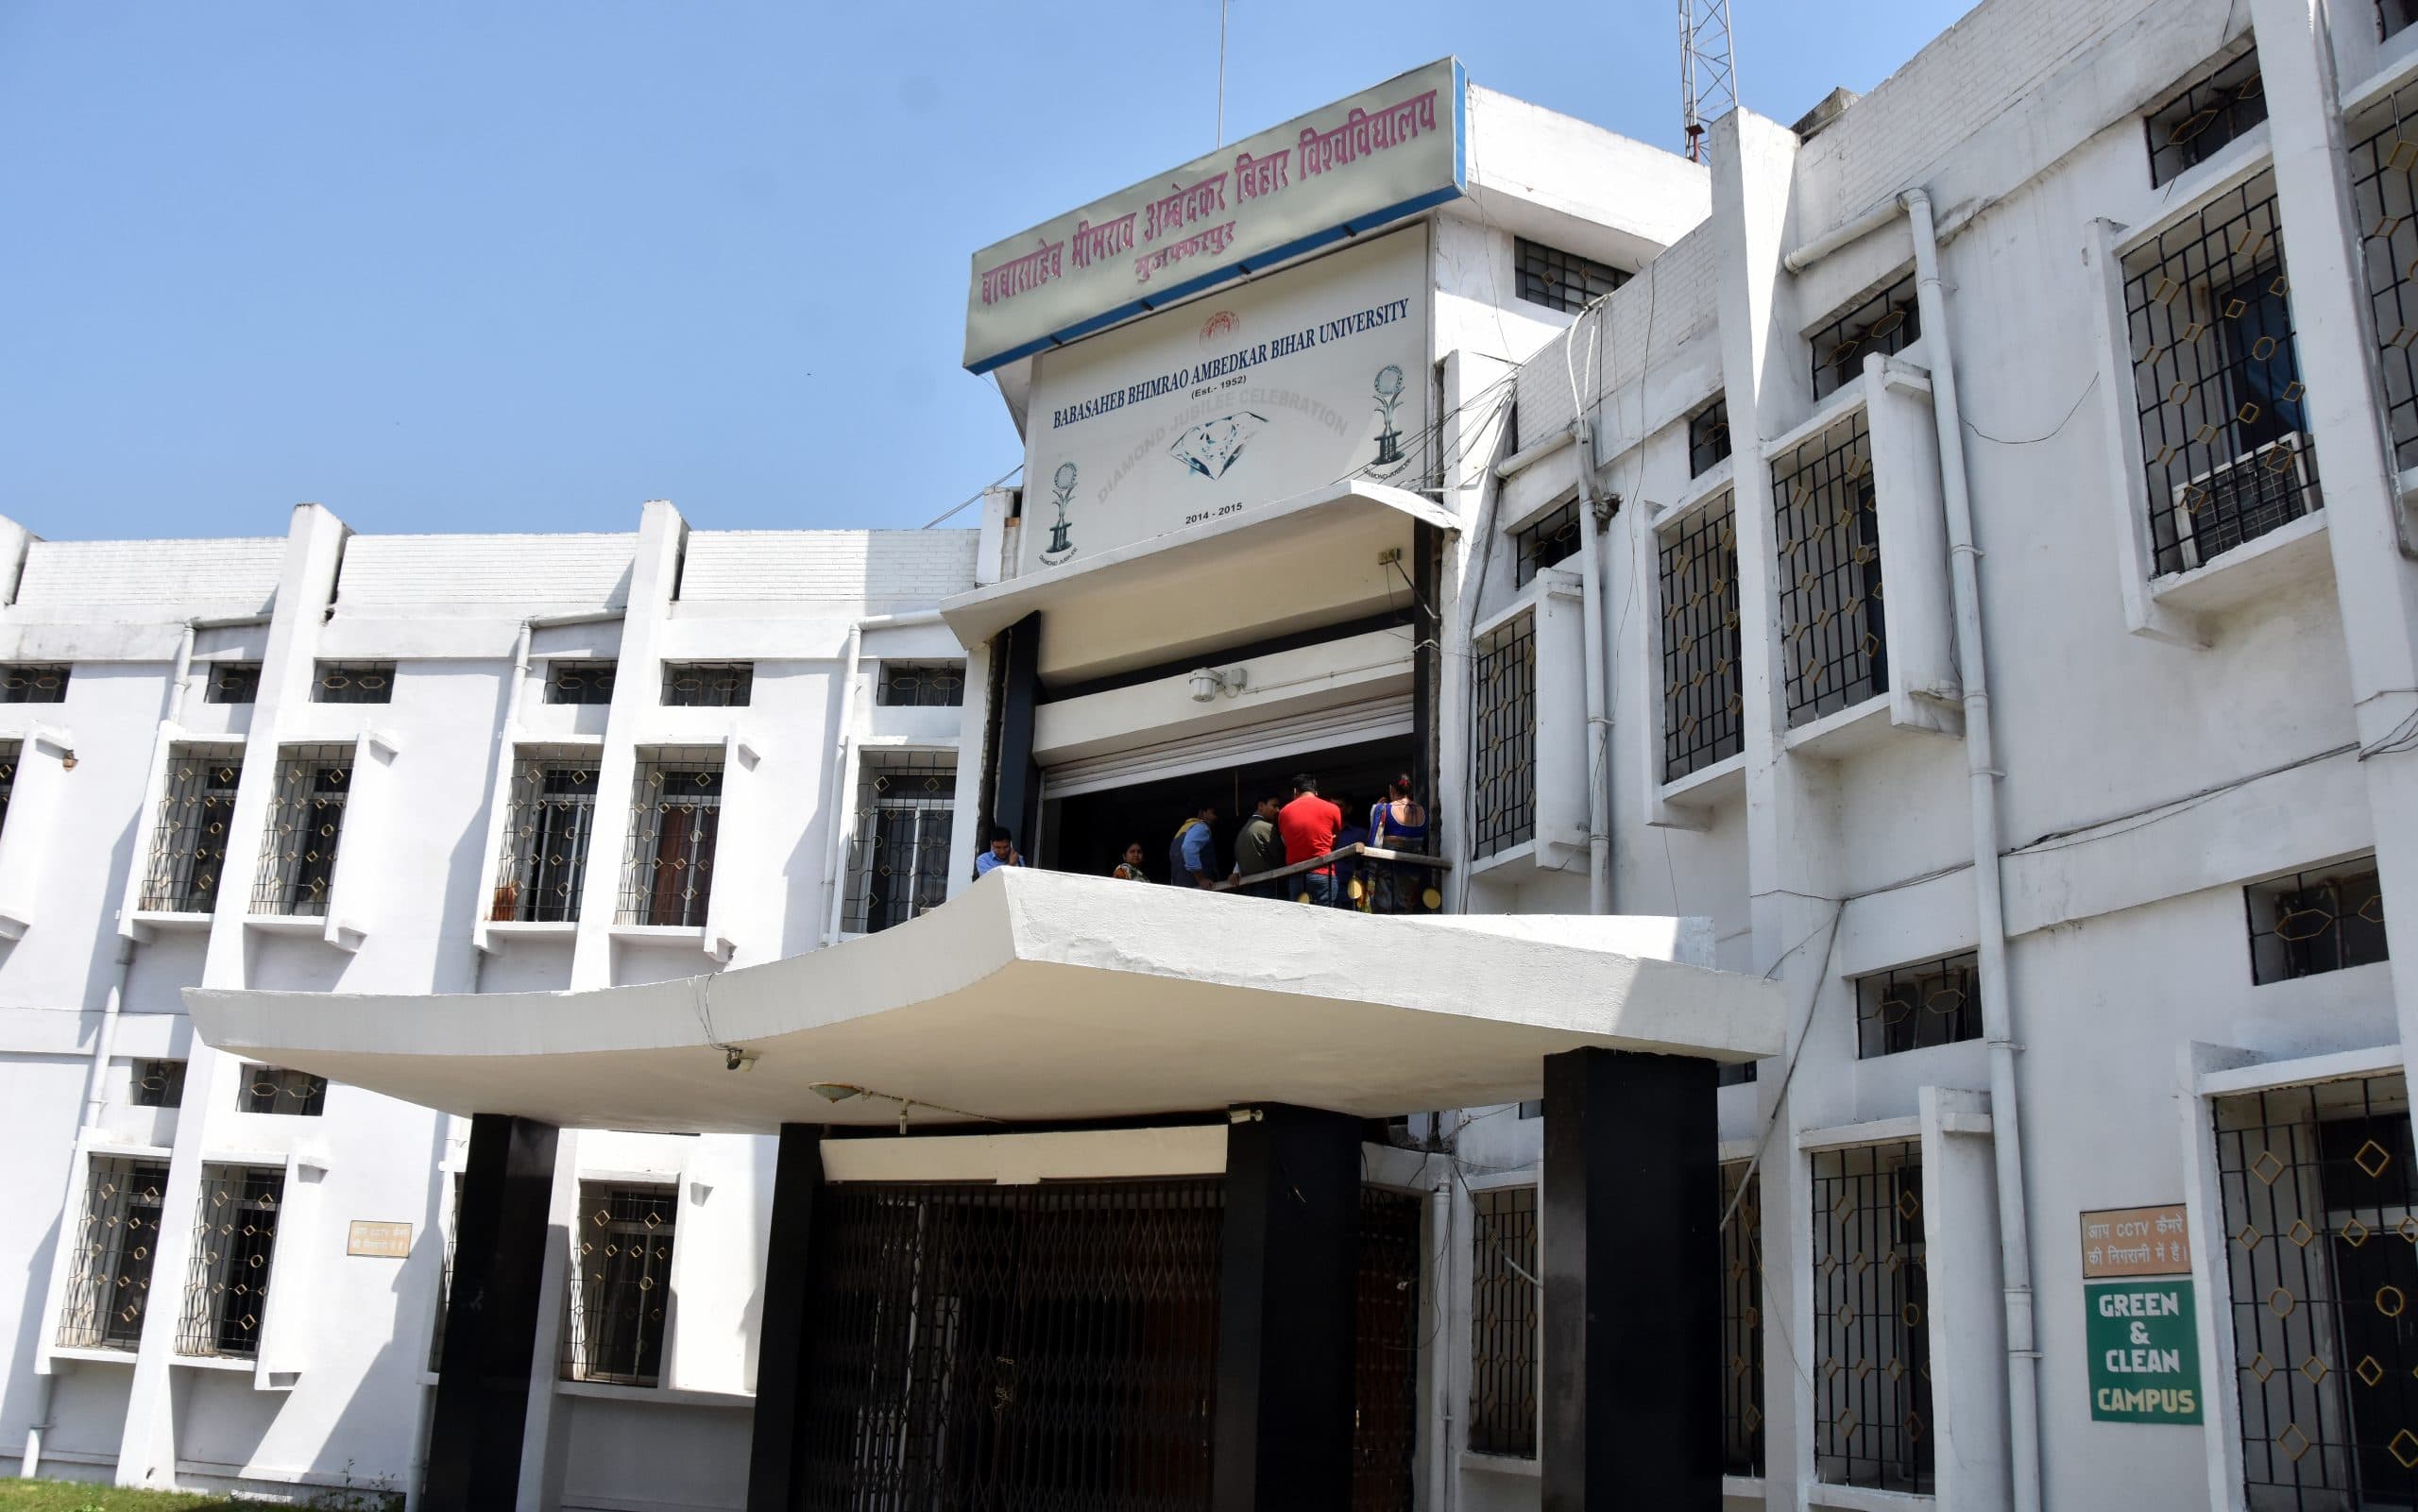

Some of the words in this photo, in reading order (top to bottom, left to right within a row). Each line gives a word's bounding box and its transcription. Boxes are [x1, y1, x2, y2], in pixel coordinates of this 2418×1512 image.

[981, 238, 1064, 305] बाबासाहेब
[1071, 212, 1137, 269] भीमराव
[1235, 149, 1291, 204] बिहार
[1299, 89, 1438, 181] विश्वविद्यालय
[1053, 388, 1126, 430] BABASAHEB
[1127, 368, 1189, 404] BHIMRAO
[1191, 344, 1269, 385] AMBEDKAR
[1270, 328, 1316, 361] BIHAR
[1319, 297, 1409, 345] UNIVERSITY
[1220, 374, 1247, 391] 1952)
[1097, 427, 1166, 505] DIAMOND
[1169, 391, 1234, 433] JUBILEE
[1238, 387, 1349, 438] CELEBRATION
[1185, 511, 1210, 525] 2014
[1218, 501, 1243, 517] 2015
[2087, 1223, 2110, 1240] आप
[2116, 1221, 2150, 1238] CCTV
[2087, 1246, 2103, 1266] की
[2107, 1243, 2151, 1266] निगरानी
[2098, 1291, 2179, 1317] GREEN
[2130, 1321, 2151, 1345] &
[2105, 1349, 2180, 1373] CLEAN
[2098, 1387, 2196, 1414] CAMPUS
